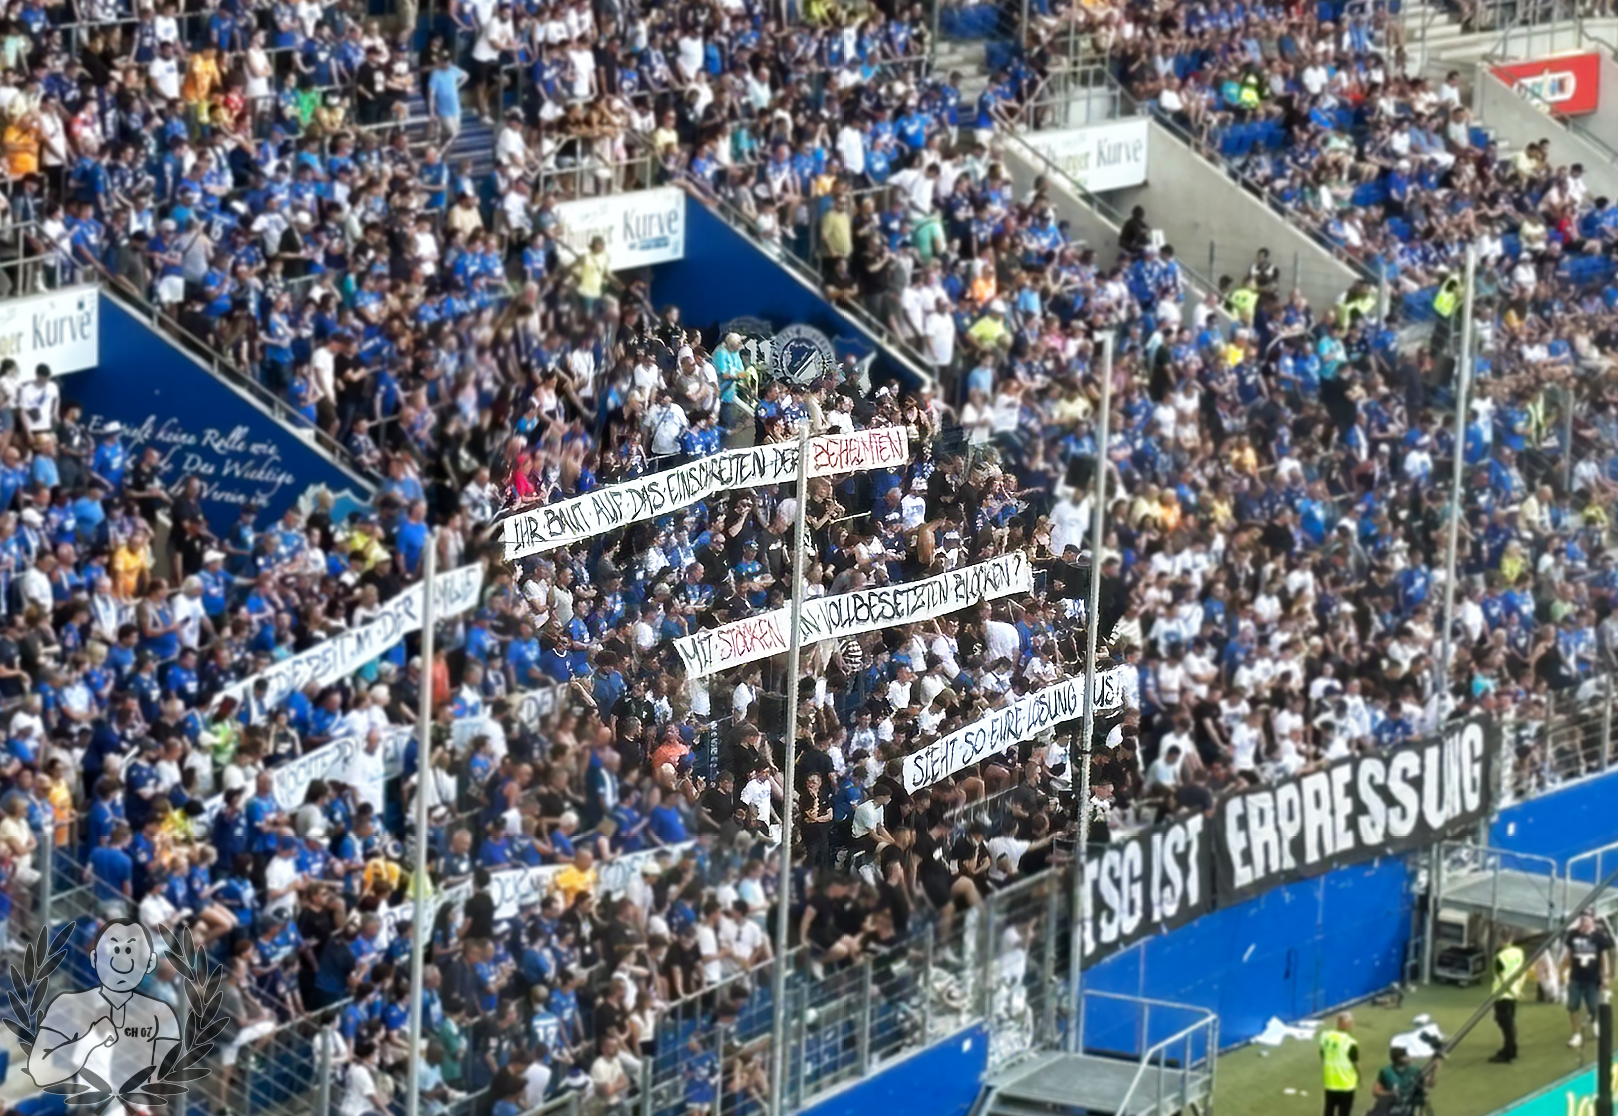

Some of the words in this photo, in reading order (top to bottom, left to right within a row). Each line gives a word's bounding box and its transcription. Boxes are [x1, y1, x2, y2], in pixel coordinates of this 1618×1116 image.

[1096, 137, 1144, 168] Kurve
[622, 206, 679, 242] Kurve
[32, 311, 92, 351] Kurve
[513, 516, 546, 551] IHR
[544, 502, 591, 537] BAUT
[591, 490, 624, 527] AUF
[626, 481, 665, 520] DAS
[679, 633, 713, 673] MIT
[912, 736, 958, 787] SIEHT
[961, 727, 987, 766] SO
[989, 708, 1023, 750] EURE
[1083, 840, 1143, 957] TSG
[1151, 812, 1204, 923] IST
[1225, 723, 1484, 889] ERPRESSUNG
